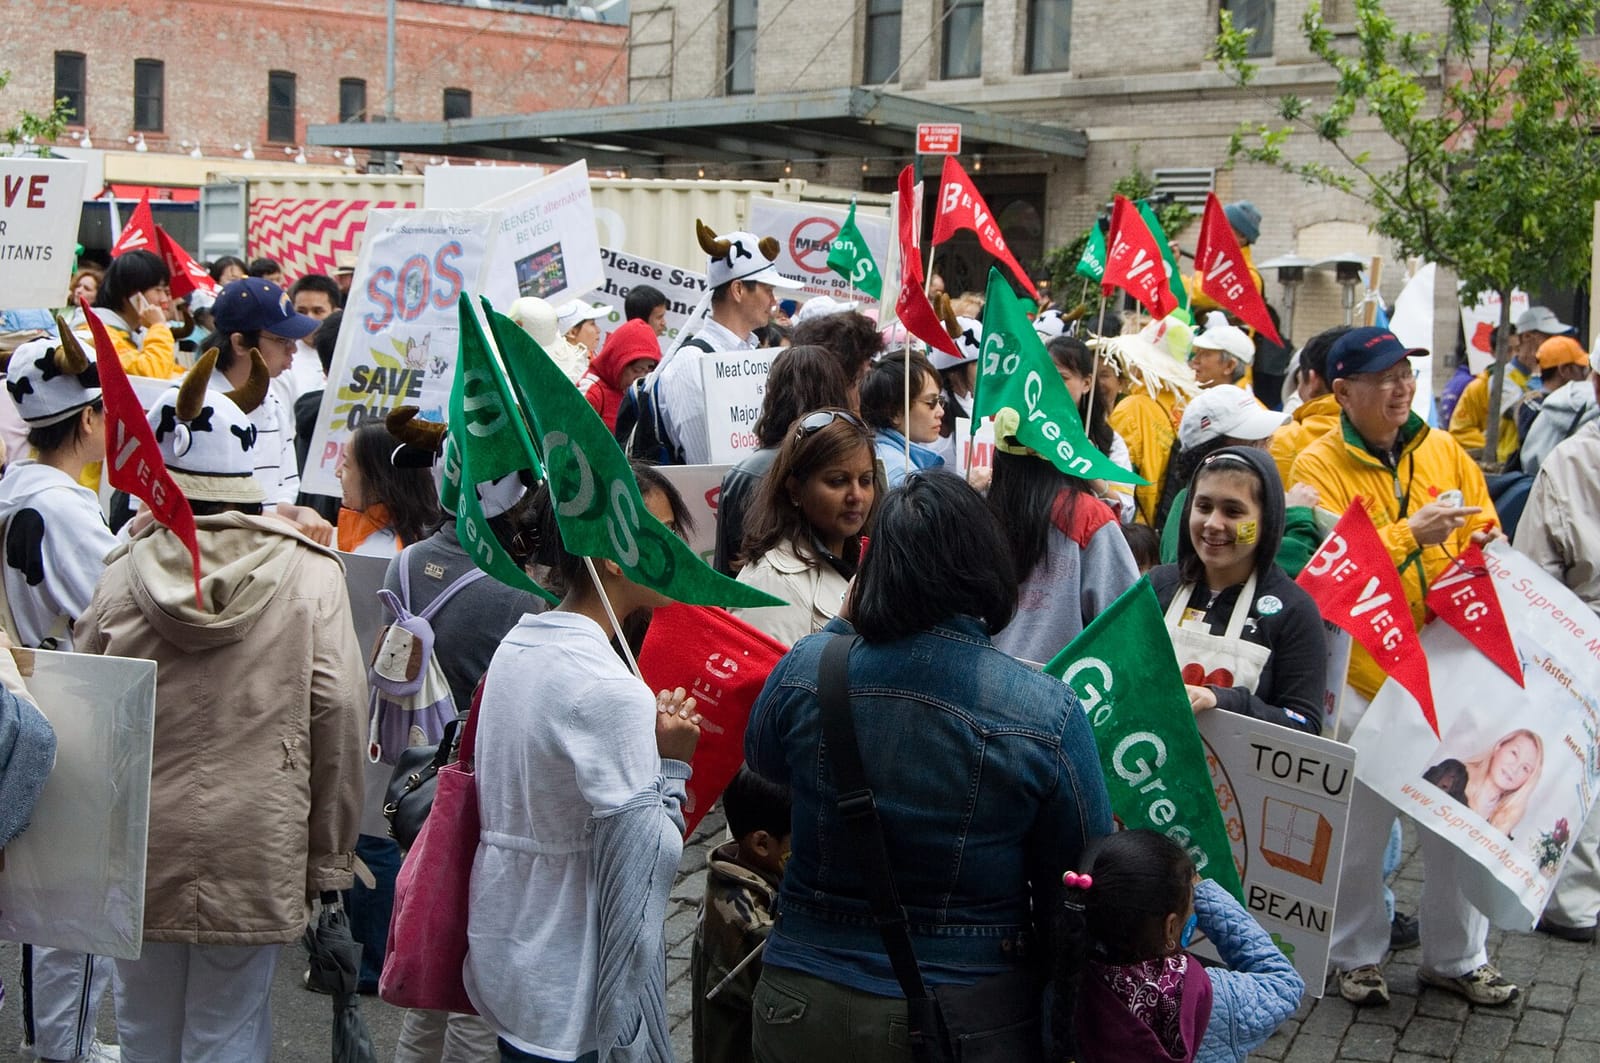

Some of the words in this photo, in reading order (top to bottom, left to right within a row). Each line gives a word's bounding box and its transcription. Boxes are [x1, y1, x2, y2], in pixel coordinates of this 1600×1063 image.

[498, 204, 541, 234] REENEST
[516, 229, 530, 245] BE
[531, 219, 553, 238] VEG!
[795, 237, 834, 253] MEA
[363, 240, 465, 335] SOS
[668, 268, 709, 293] Sav
[811, 275, 828, 286] for
[350, 364, 426, 399] SAVE
[716, 361, 741, 378] Meat
[743, 359, 771, 376] Cons
[757, 383, 763, 394] is
[982, 332, 1020, 376] Go
[1024, 370, 1094, 475] Green
[730, 404, 759, 425] Major
[730, 431, 763, 449] Globa
[443, 431, 494, 566] Geen
[1305, 530, 1358, 582] BE
[1350, 575, 1404, 662] VEG.
[1484, 552, 1512, 581] The
[1511, 577, 1586, 640] Supreme
[1541, 657, 1573, 689] fastest
[1062, 656, 1114, 727] Go
[1250, 743, 1349, 796] TOFU
[1248, 885, 1329, 933] BEAN
